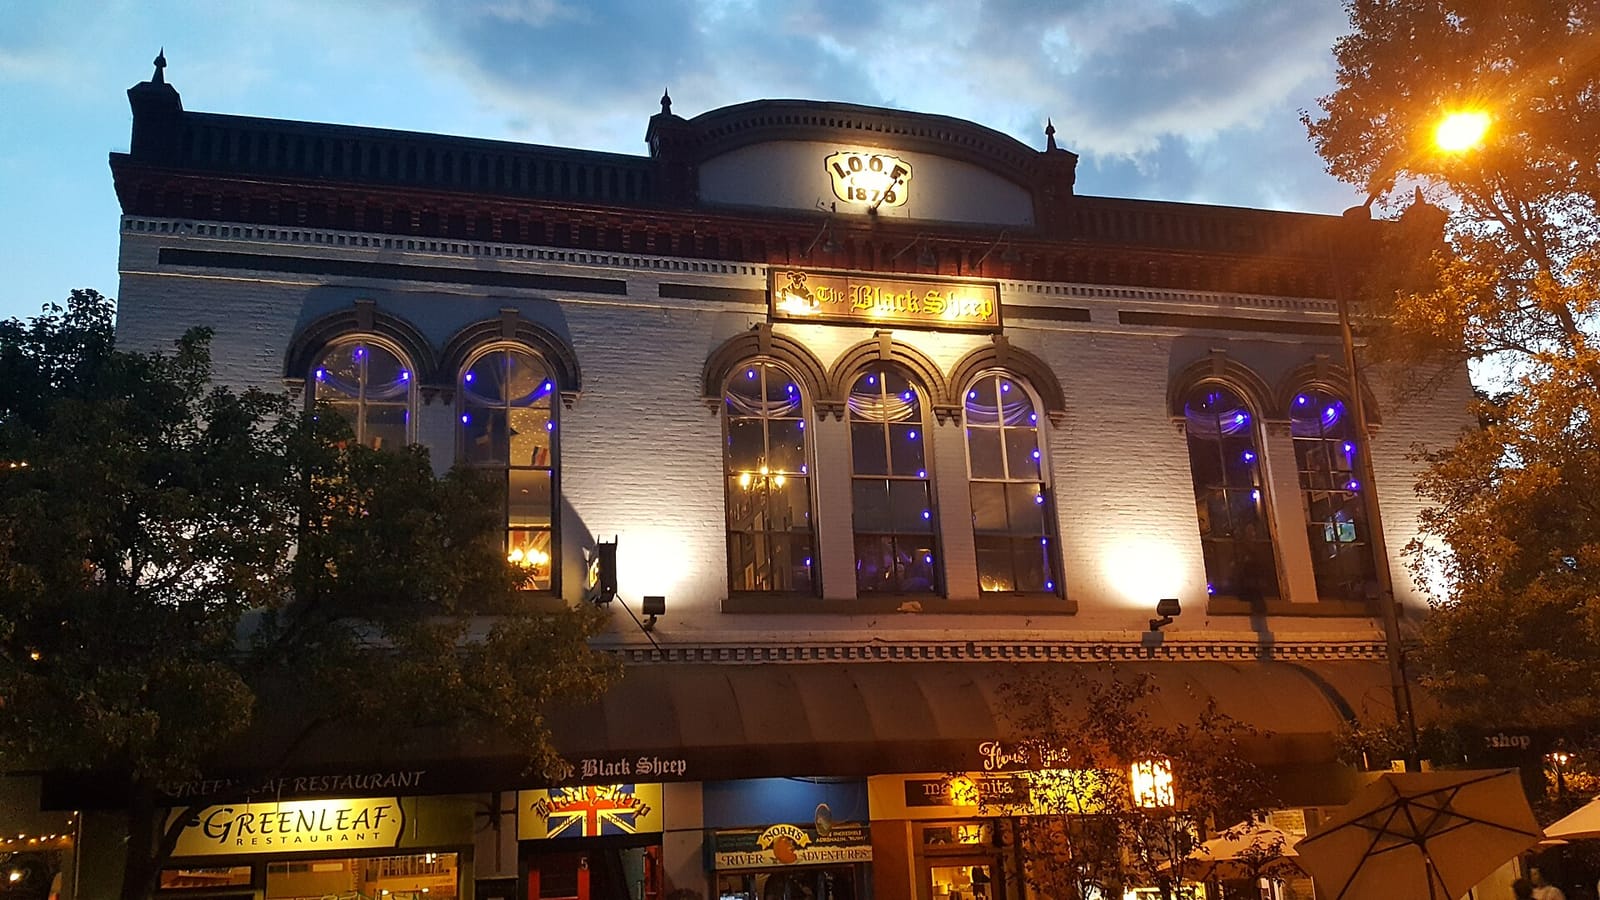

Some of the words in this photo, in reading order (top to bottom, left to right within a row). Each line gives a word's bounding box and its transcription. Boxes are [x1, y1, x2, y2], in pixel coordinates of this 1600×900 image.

[815, 286, 845, 304] The
[850, 284, 921, 313] Black
[923, 288, 994, 320] Sheep
[581, 758, 631, 780] Black
[635, 756, 687, 776] Sheep
[294, 770, 426, 792] RESTAURANT
[923, 780, 1014, 795] manita
[203, 805, 393, 844] GREENLEAF
[236, 831, 381, 846] RESTAURANT
[762, 826, 803, 843] NOAH'S
[580, 857, 589, 870] 5
[722, 853, 764, 866] RIVER
[801, 850, 868, 862] ADVENTURES
